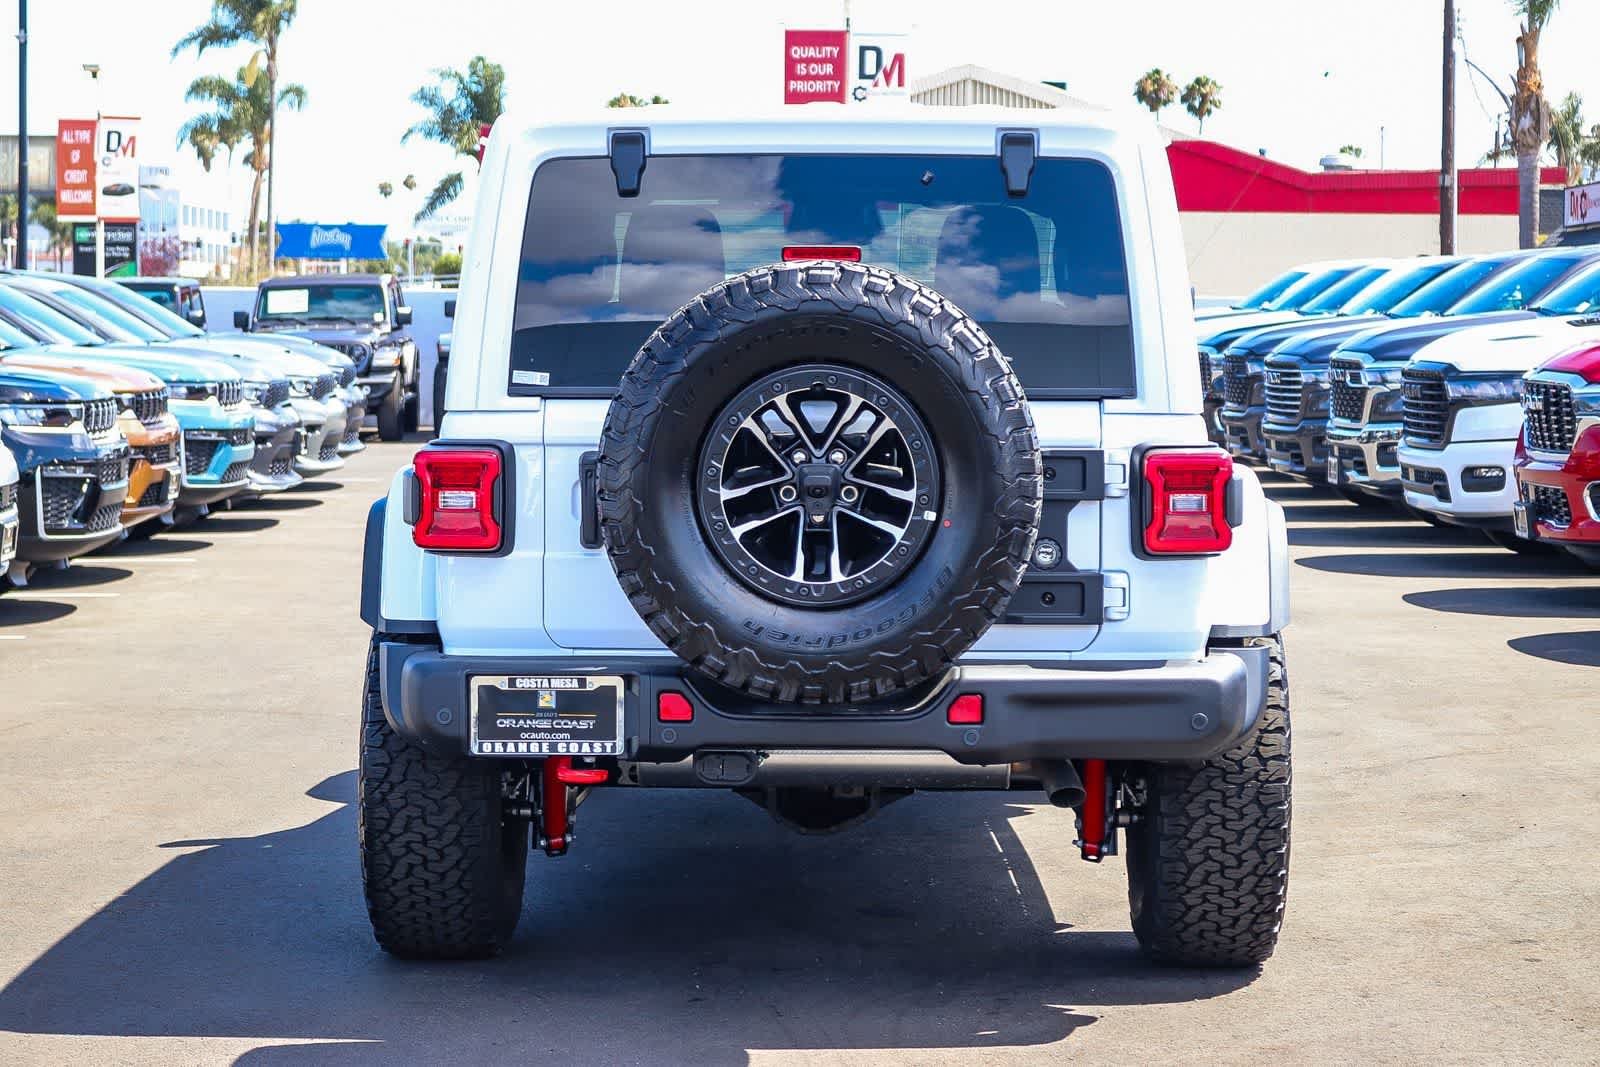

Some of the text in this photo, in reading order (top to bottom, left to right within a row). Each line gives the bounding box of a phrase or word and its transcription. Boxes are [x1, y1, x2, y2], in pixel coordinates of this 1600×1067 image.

[791, 46, 840, 59] QUALITY
[797, 63, 834, 76] IS OUR
[789, 80, 840, 93] PRIORITY
[63, 169, 88, 184] CREDIT
[60, 189, 93, 204] WELCOME
[515, 678, 579, 689] COSTA MESA
[496, 718, 596, 729] ORANGE COAST
[520, 731, 570, 740] ocauto.com
[482, 742, 614, 753] ORANGE COAST
